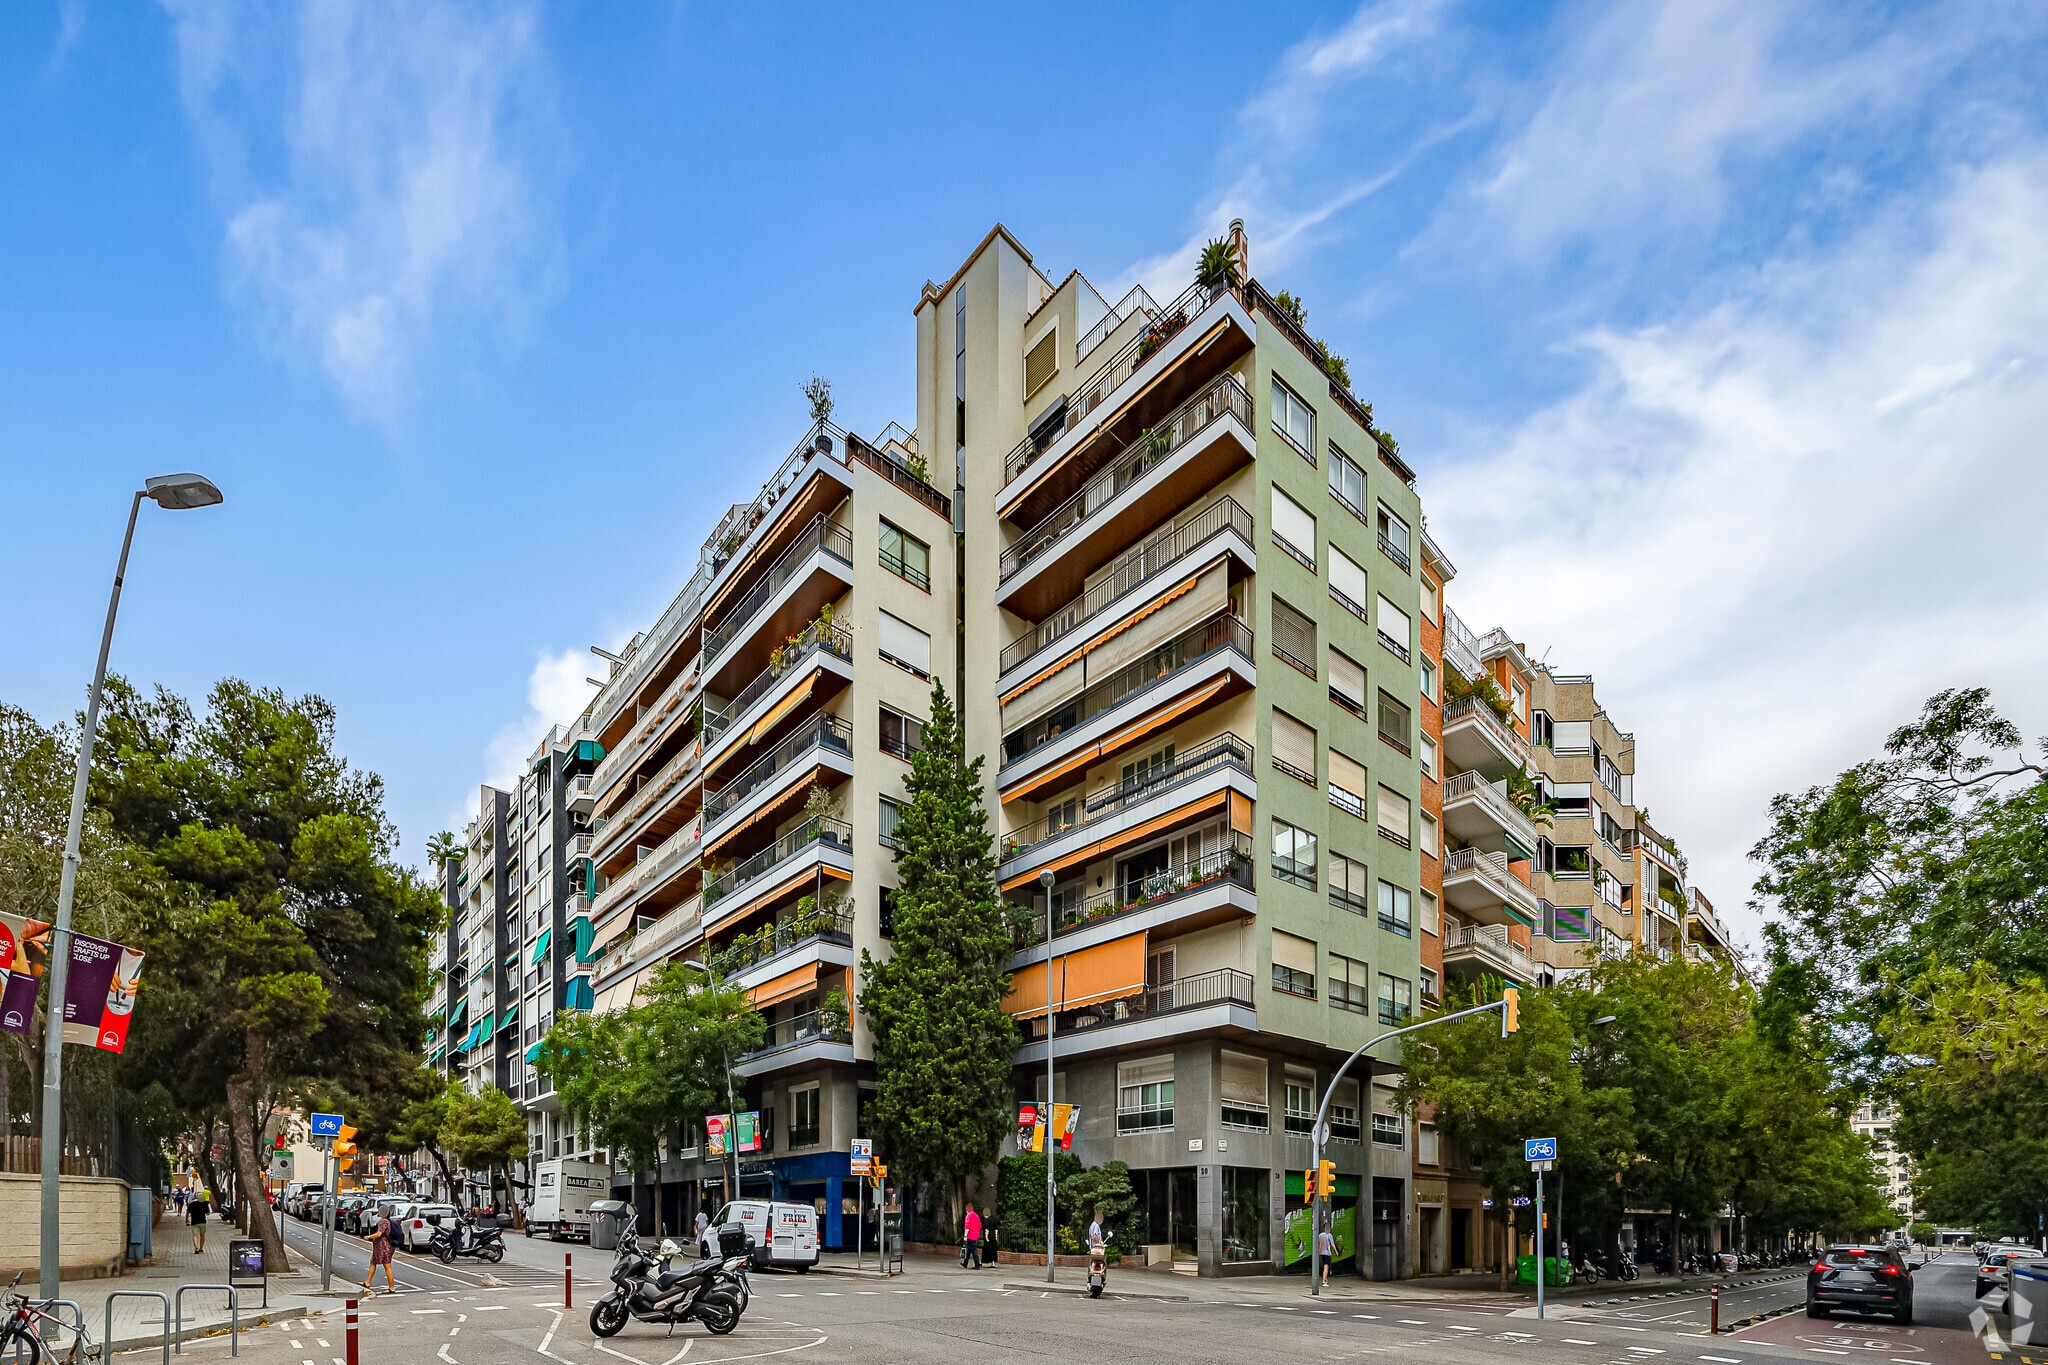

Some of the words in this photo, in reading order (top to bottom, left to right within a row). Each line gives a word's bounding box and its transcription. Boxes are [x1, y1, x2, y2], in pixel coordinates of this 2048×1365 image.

[74, 938, 108, 953] DISCOVER
[73, 946, 99, 958] CRAFTS
[99, 952, 110, 960] UP
